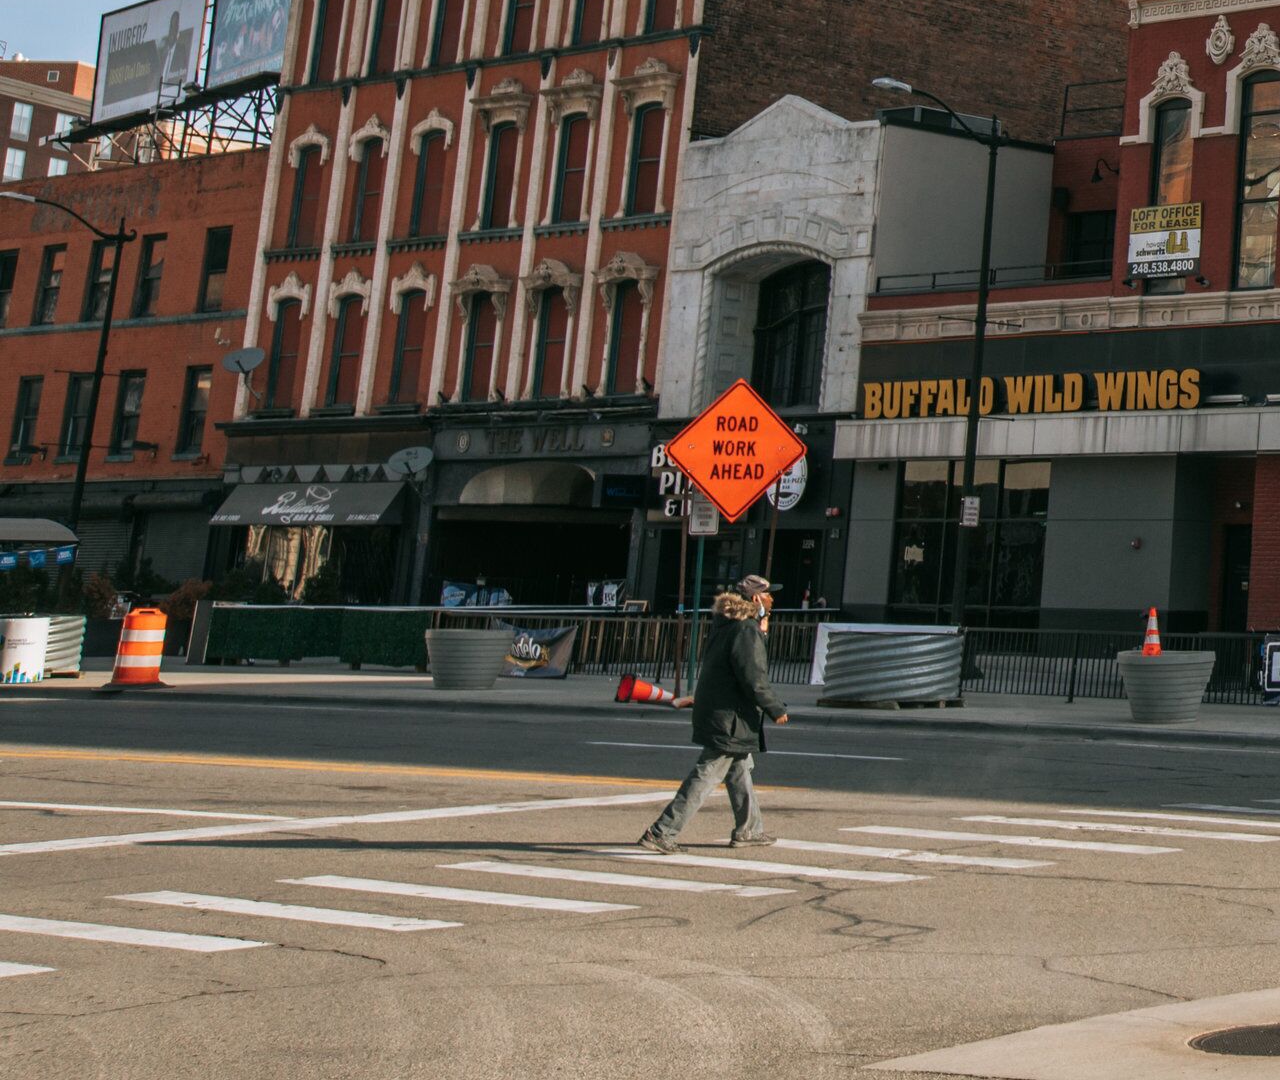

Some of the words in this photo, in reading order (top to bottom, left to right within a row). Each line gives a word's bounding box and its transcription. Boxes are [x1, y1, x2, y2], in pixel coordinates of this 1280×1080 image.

[109, 22, 148, 54] INJURED?
[1133, 208, 1158, 222] LOFT
[1161, 205, 1199, 219] OFFICE
[1134, 221, 1155, 231] FOR
[1160, 217, 1197, 228] LEASE
[1132, 260, 1194, 274] 248.538.4800
[864, 377, 994, 419] BUFFALO
[1004, 373, 1083, 414] WILD
[1094, 368, 1200, 411] WINGS
[716, 416, 759, 432] ROAD
[485, 428, 524, 454] THE
[532, 426, 584, 452] WELL
[713, 440, 756, 456] WORK
[710, 463, 765, 480] AHEAD
[511, 637, 541, 659] odelo
